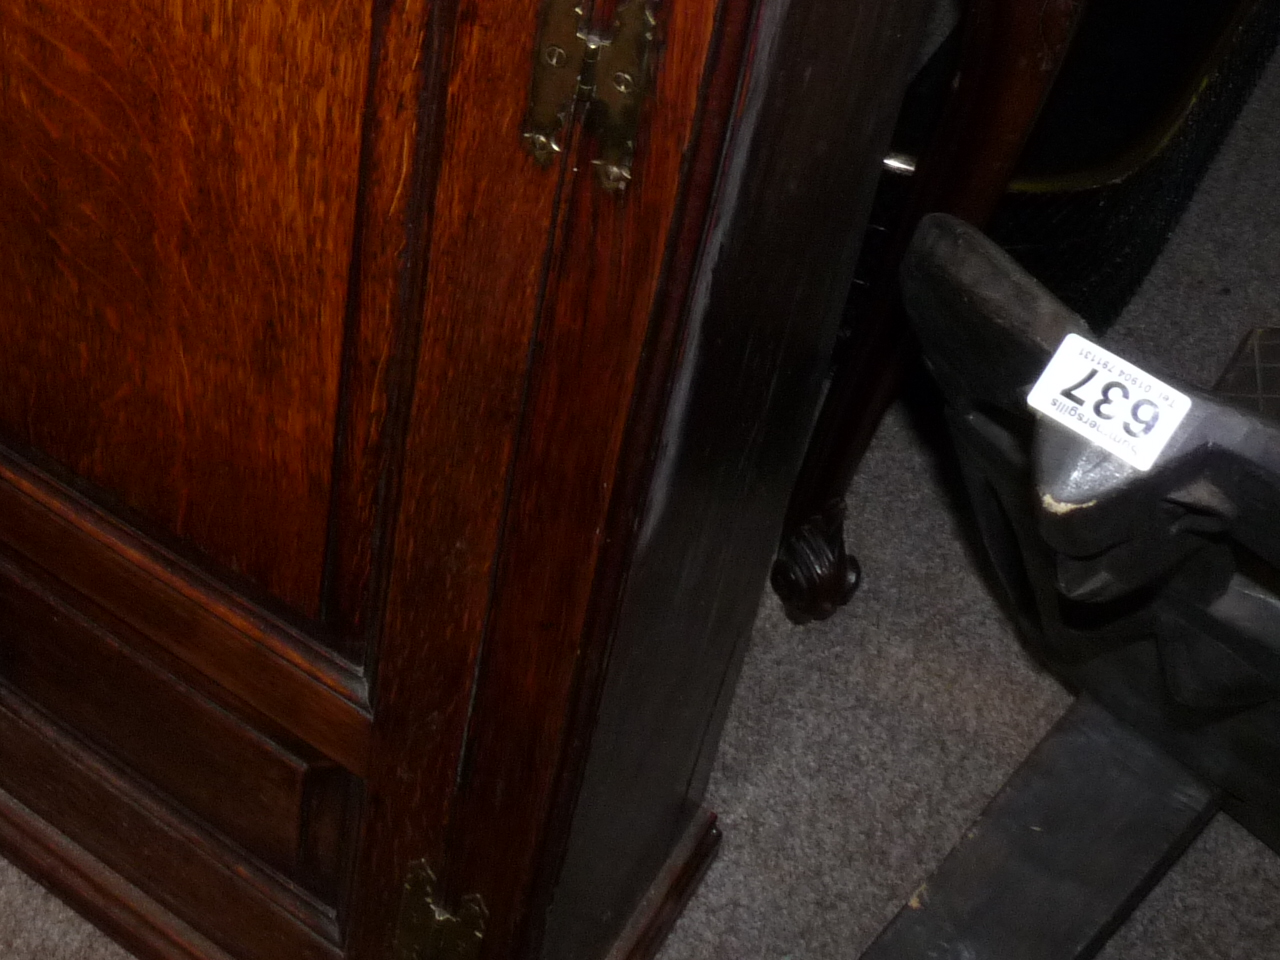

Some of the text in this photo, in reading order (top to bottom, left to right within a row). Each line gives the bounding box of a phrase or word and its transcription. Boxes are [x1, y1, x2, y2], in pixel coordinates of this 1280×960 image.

[1078, 347, 1115, 373] 791131
[1118, 369, 1152, 392] 01904
[1059, 368, 1160, 438] 637
